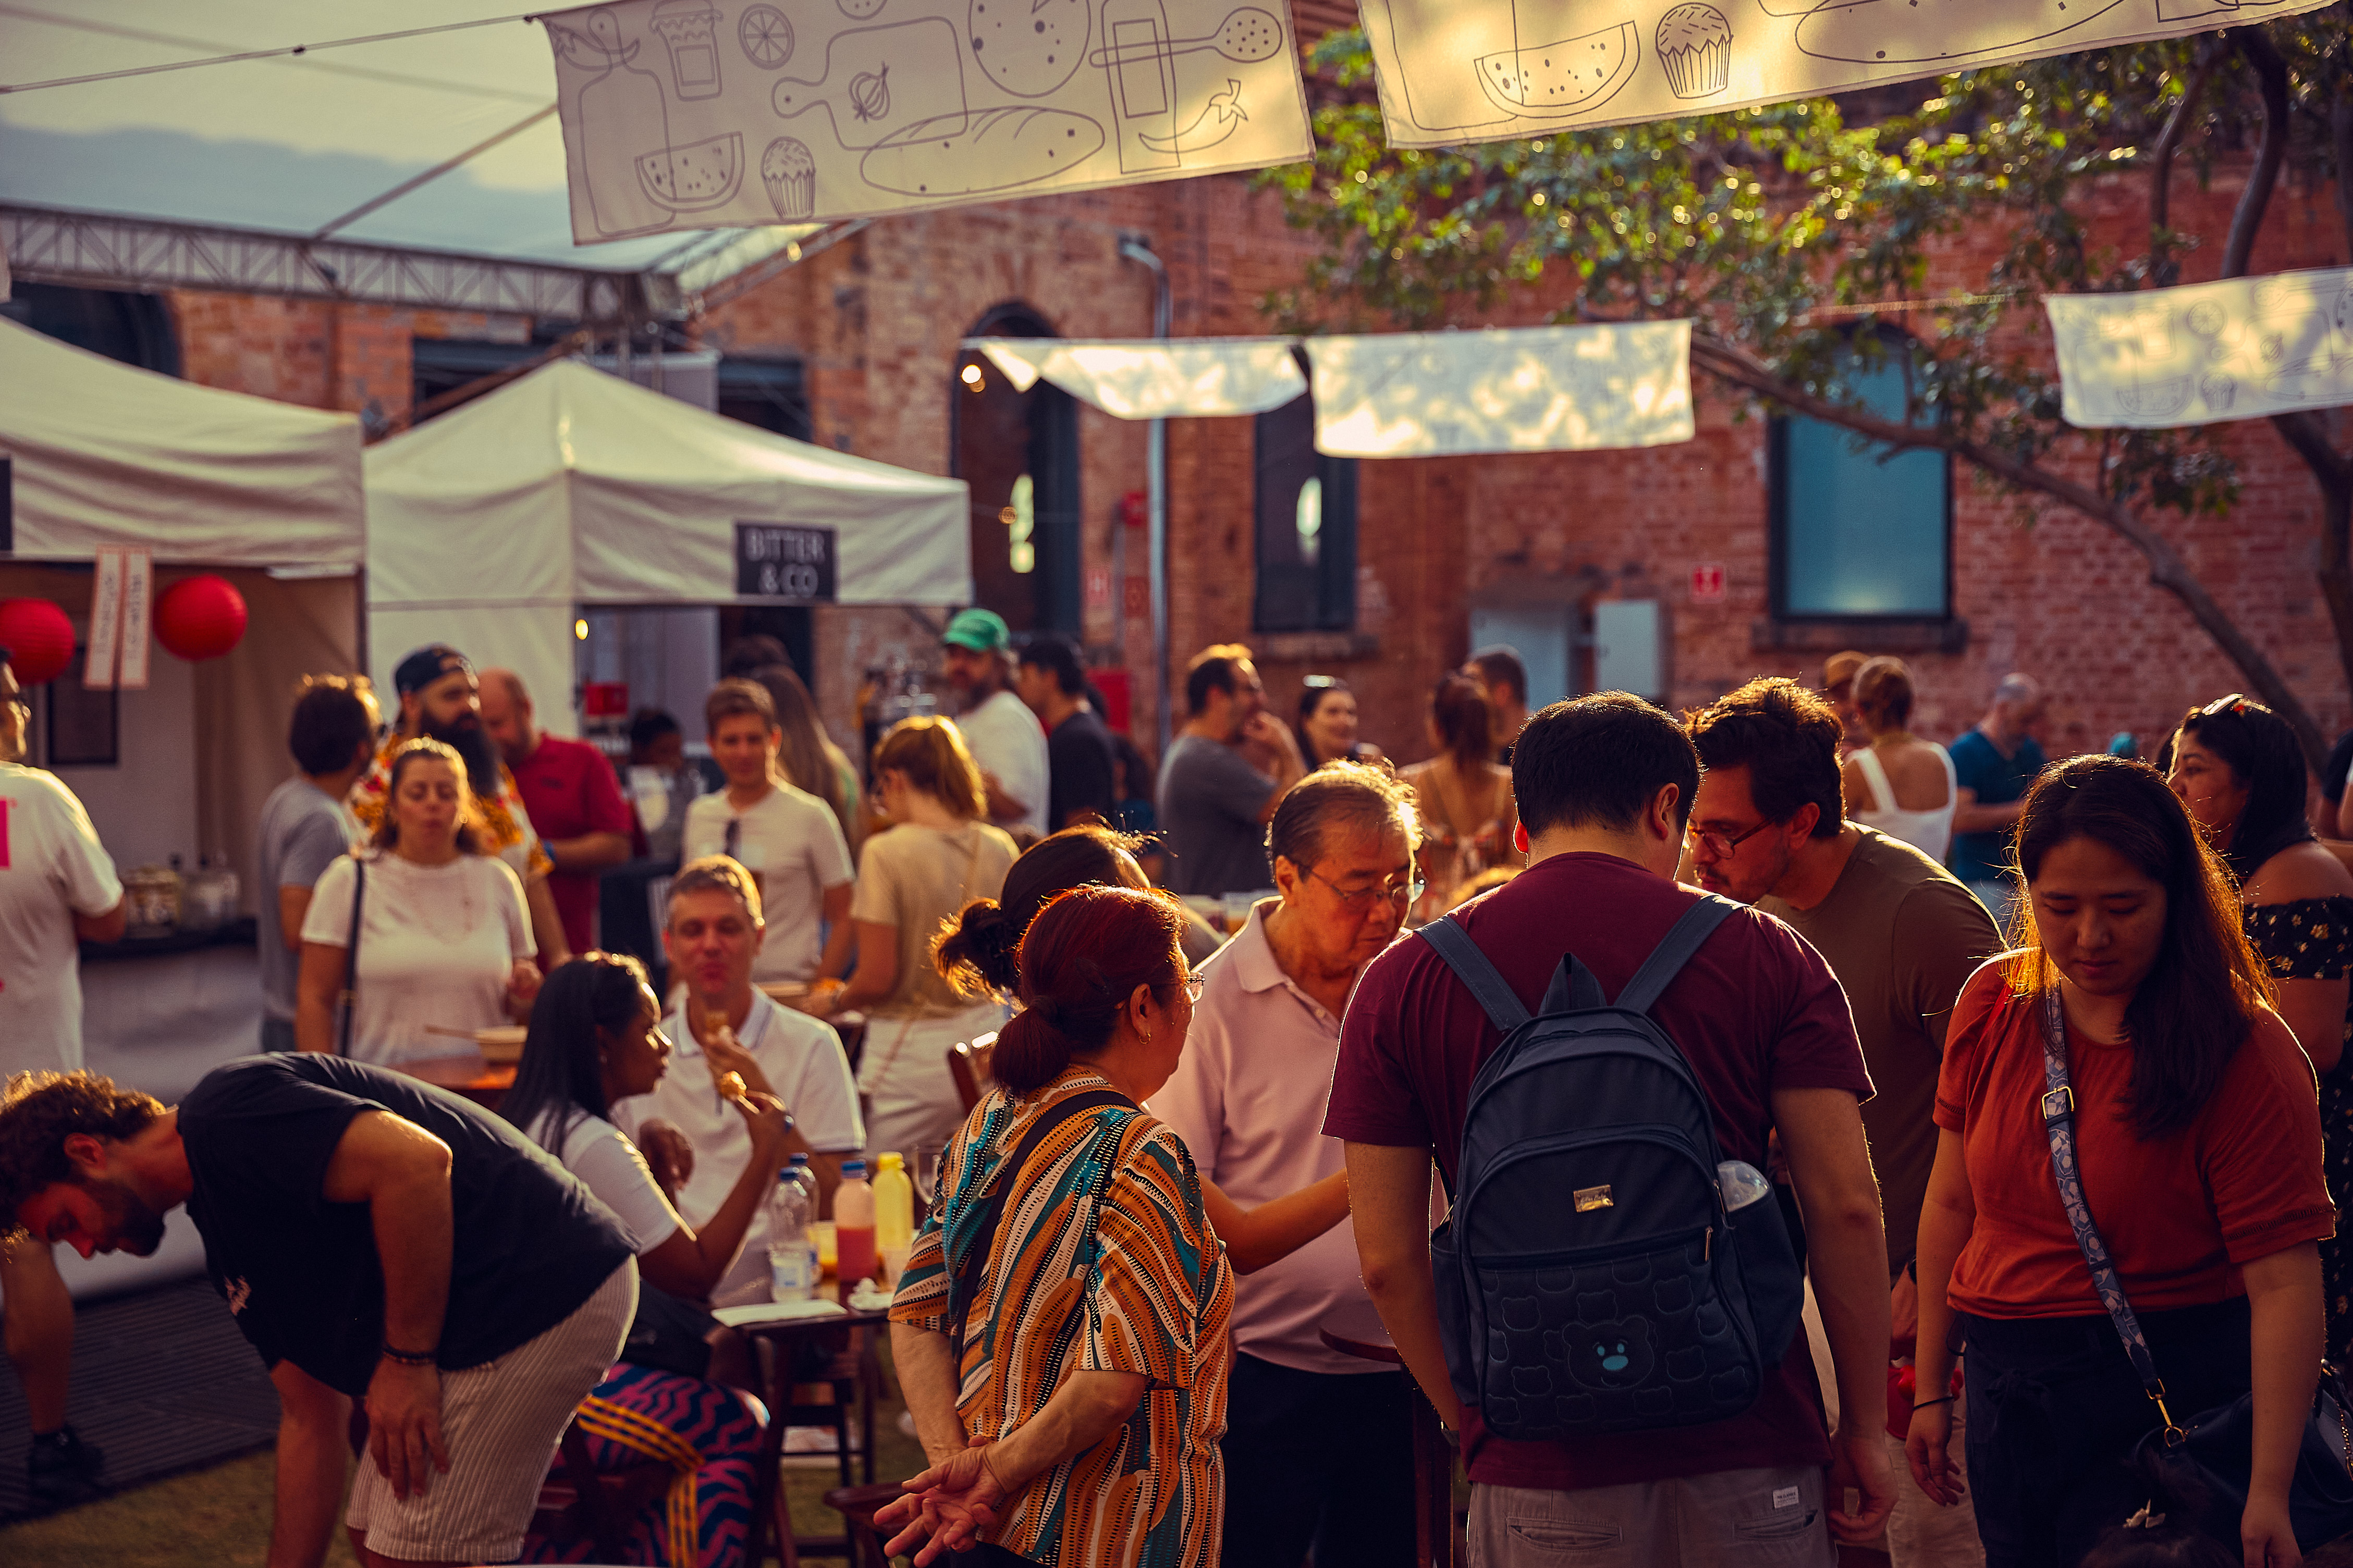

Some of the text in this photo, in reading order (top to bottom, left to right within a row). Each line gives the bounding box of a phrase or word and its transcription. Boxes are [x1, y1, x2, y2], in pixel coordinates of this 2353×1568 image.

[745, 528, 825, 564] BITTER
[758, 563, 819, 598] & CO
